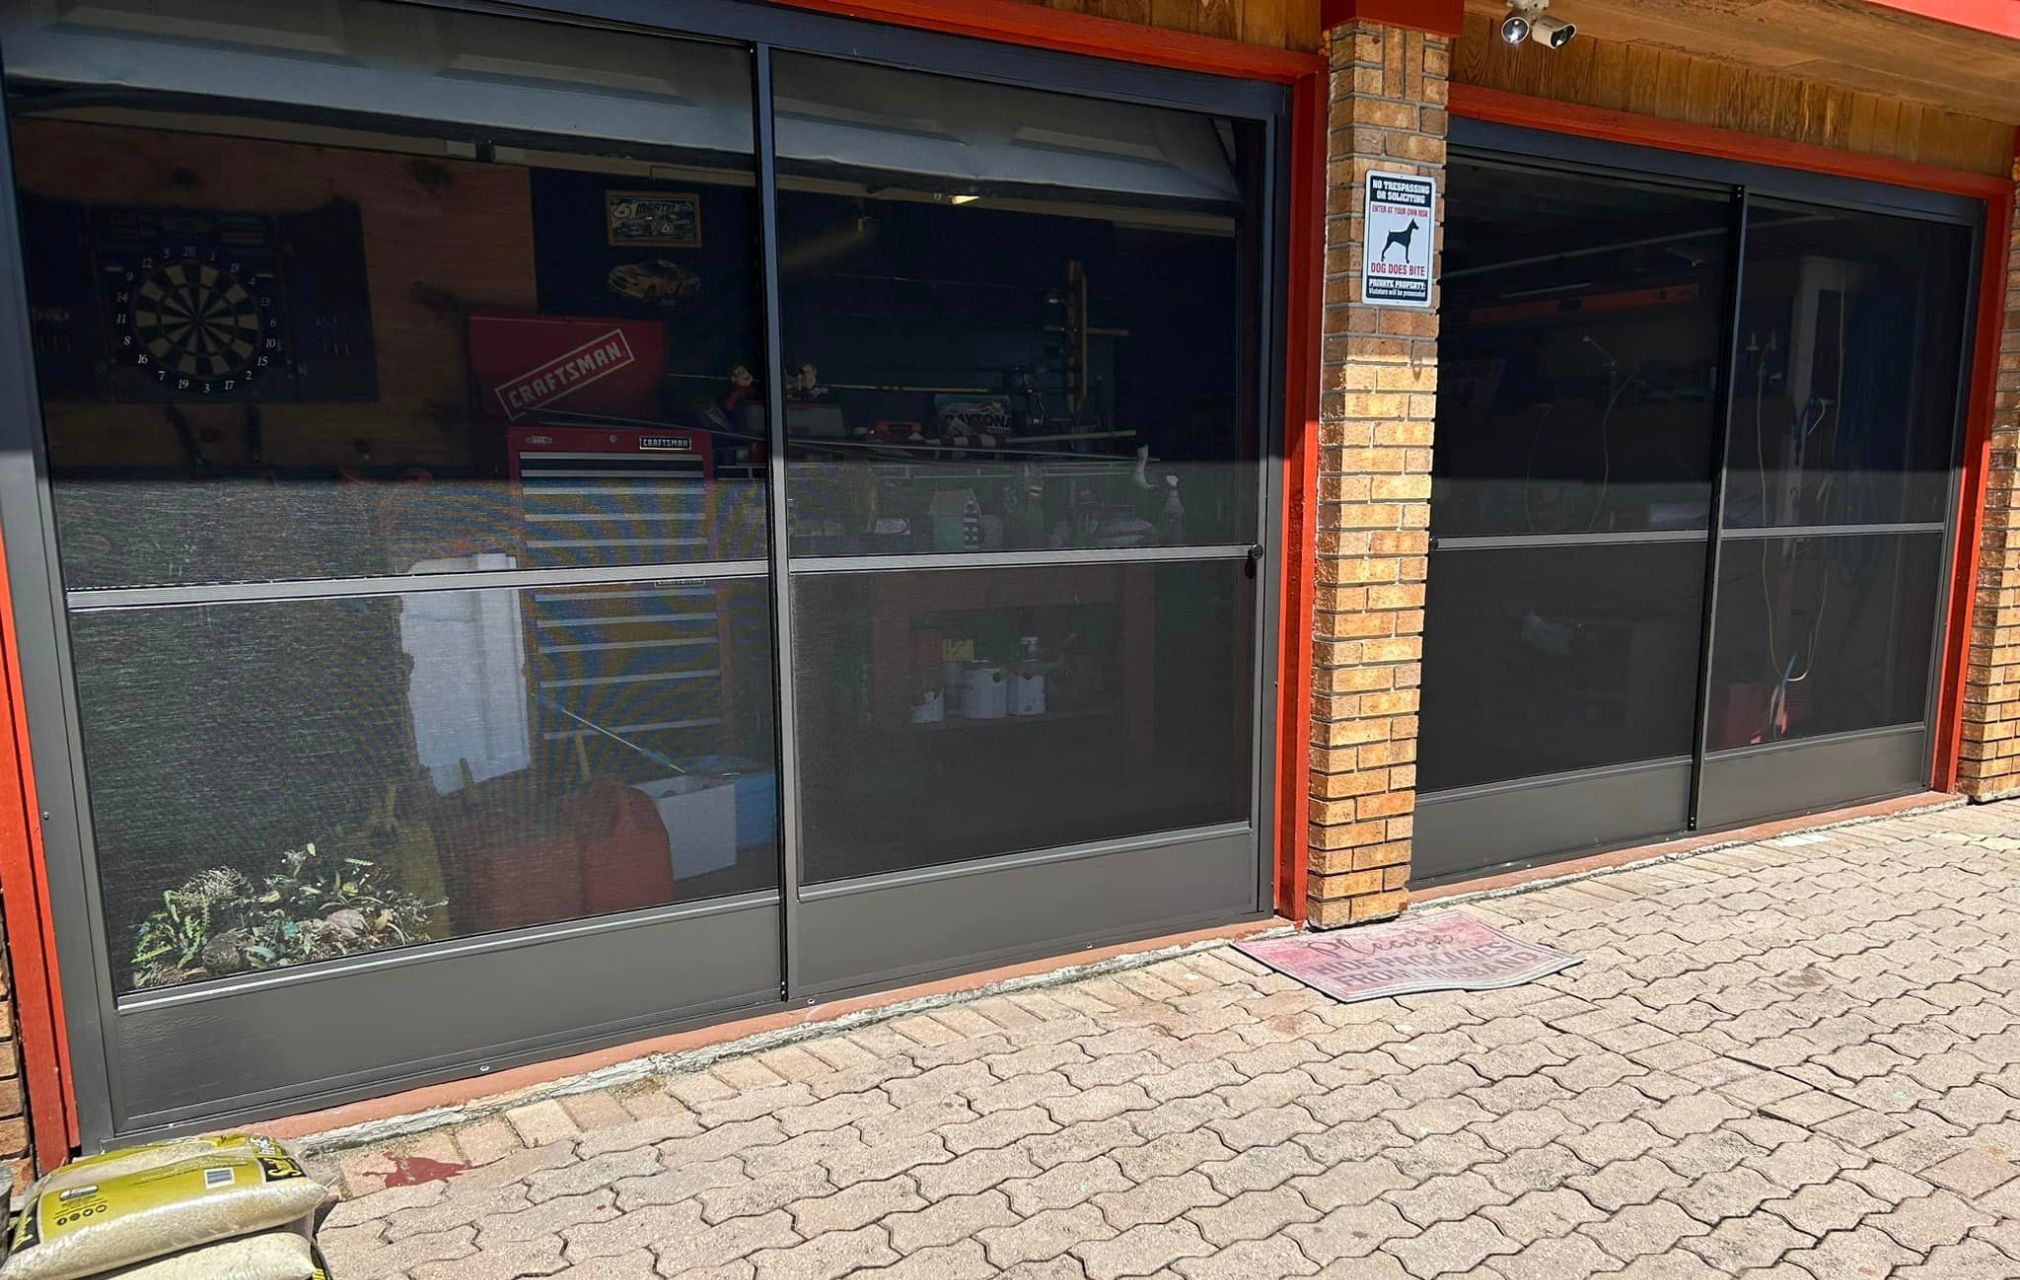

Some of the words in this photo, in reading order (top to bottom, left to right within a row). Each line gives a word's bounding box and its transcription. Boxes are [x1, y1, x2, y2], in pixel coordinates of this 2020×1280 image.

[1373, 179, 1382, 189] NO
[1384, 181, 1430, 195] TRESPASSING
[1377, 190, 1386, 200] OR
[1388, 191, 1425, 204] SOLICITING
[1372, 204, 1386, 213] ENTER
[1394, 207, 1406, 215] YOUR
[1407, 208, 1417, 216] OWN
[1418, 209, 1428, 218] RISK
[182, 246, 196, 257] 20
[211, 251, 216, 261] 1
[1371, 262, 1386, 273] DOG
[1388, 263, 1407, 275] DOES
[1409, 265, 1425, 277] BITE
[126, 271, 134, 281] 9
[116, 313, 127, 324] 11
[270, 318, 277, 328] 6
[123, 335, 131, 346] 8
[265, 338, 276, 348] 10
[137, 353, 149, 365] 16
[256, 356, 268, 366] 15
[158, 370, 166, 381] 7
[245, 370, 252, 380] 2
[508, 341, 622, 409] CRAFTSMAN
[178, 379, 190, 390] 19
[202, 383, 210, 393] 3
[225, 380, 235, 391] 17
[642, 438, 689, 447] CRAFTSMAN
[1309, 958, 1380, 975] HIDE
[1375, 942, 1513, 967] PACKAGES
[1334, 968, 1412, 986] FROM
[1413, 952, 1539, 979] HUSBAND
